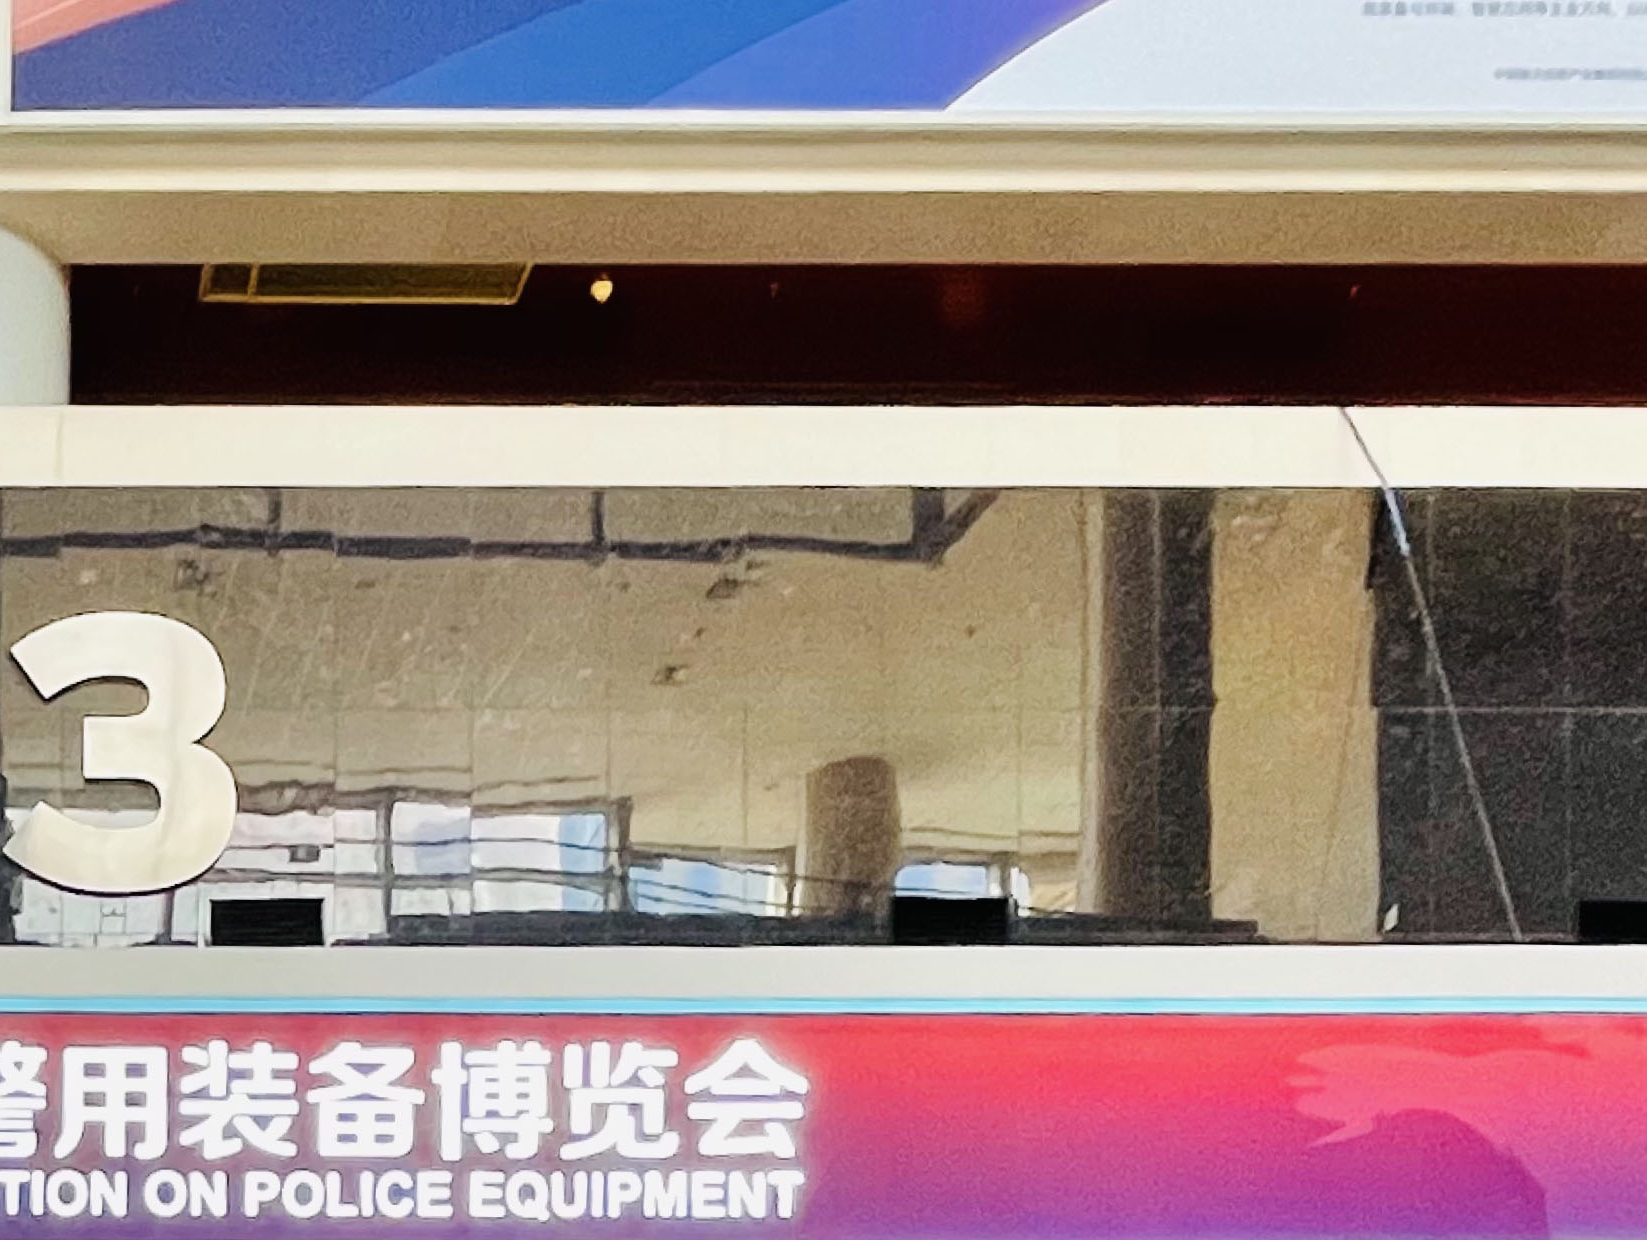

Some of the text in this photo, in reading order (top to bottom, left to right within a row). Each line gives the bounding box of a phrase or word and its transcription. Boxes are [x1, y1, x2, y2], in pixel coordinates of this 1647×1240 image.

[2, 610, 239, 896] 3
[143, 1169, 228, 1220] ON
[243, 1169, 453, 1220] POLICE
[469, 1169, 806, 1223] EQUIPMENT
